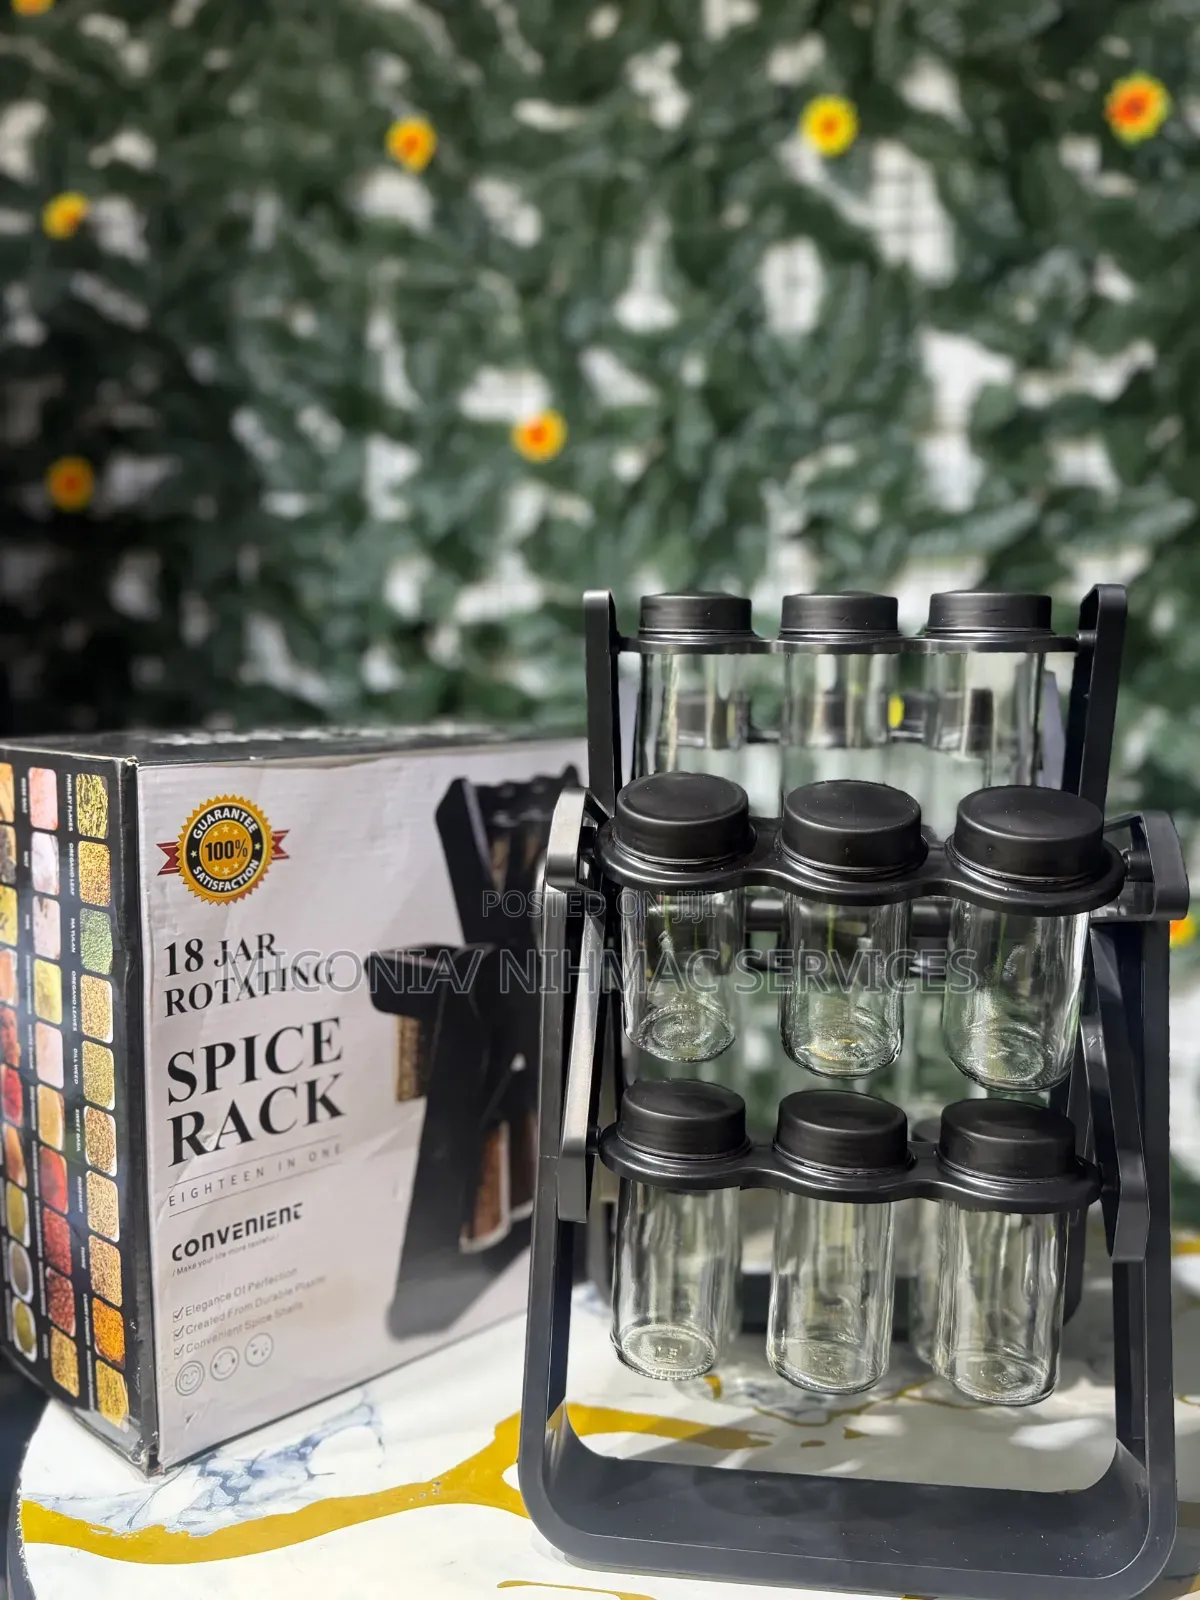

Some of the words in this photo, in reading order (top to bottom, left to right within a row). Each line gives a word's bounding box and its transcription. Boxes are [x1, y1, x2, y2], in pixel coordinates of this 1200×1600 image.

[192, 807, 259, 840] GUARANTEE
[205, 838, 249, 862] 100%
[192, 859, 260, 892] SATISFACTION
[164, 937, 204, 978] 18
[214, 932, 278, 968] JAR
[164, 958, 335, 1018] ROTATING
[167, 1016, 344, 1107] SPICE
[166, 1072, 347, 1168] RACK
[168, 1166, 265, 1208] EIGHTEEN
[278, 1157, 296, 1173] IN
[308, 1143, 343, 1163] ONE
[198, 1255, 214, 1269] your
[185, 1291, 232, 1317] Elegance
[248, 1267, 299, 1293] Perfection
[185, 1310, 226, 1336] Created
[227, 1302, 254, 1319] From
[186, 1323, 244, 1354] Convenient
[244, 1310, 273, 1331] Spice
